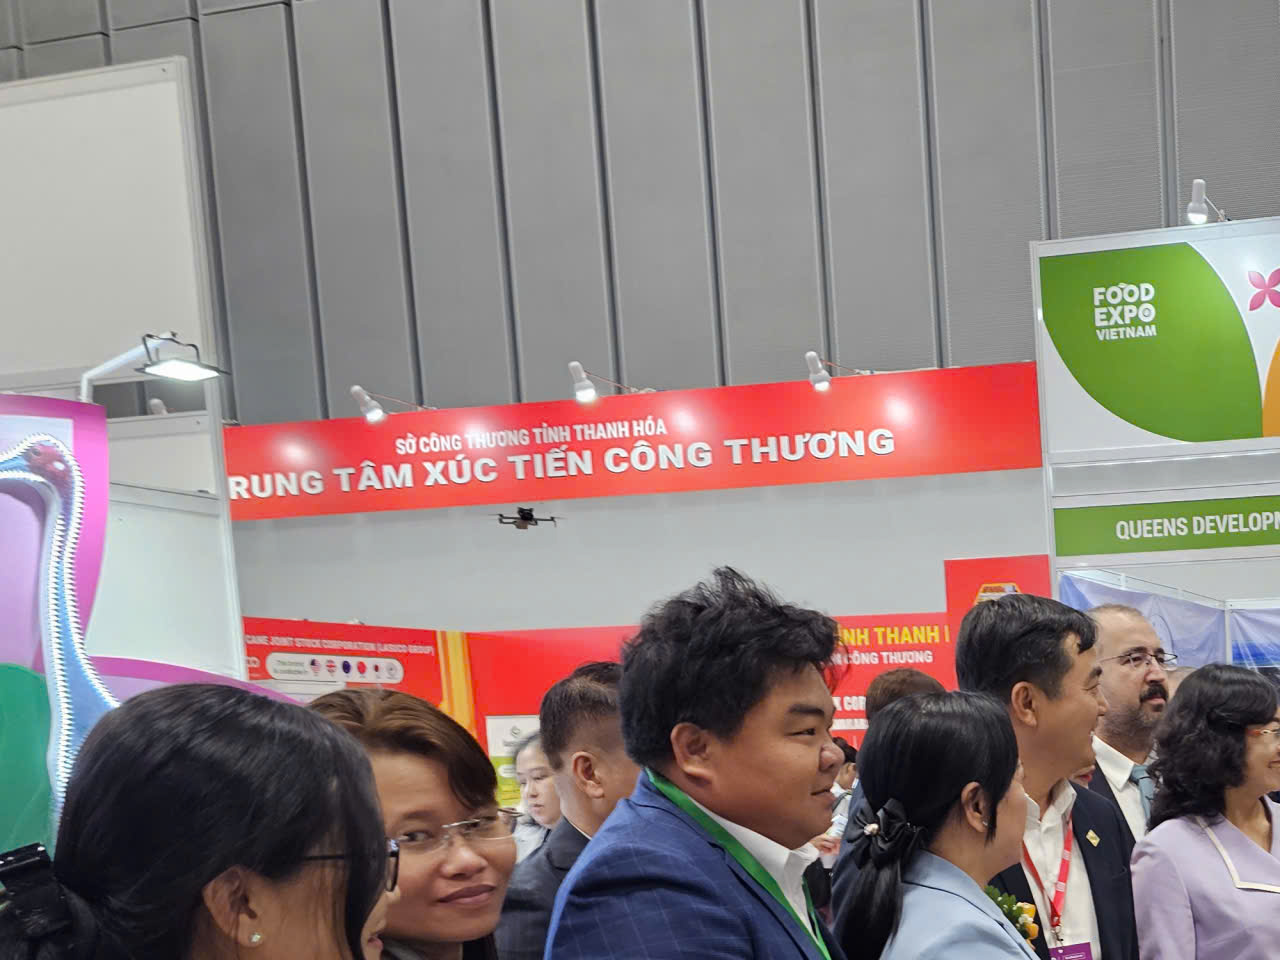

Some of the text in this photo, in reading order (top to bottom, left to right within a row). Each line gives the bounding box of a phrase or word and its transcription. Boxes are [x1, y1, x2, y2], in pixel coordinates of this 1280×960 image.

[1093, 282, 1155, 305] FOOD
[1094, 303, 1156, 326] EXPO
[1096, 325, 1157, 341] VIETNAM
[419, 432, 462, 453] CÔNG
[573, 420, 630, 441] THANH
[633, 415, 667, 437] HÓA
[228, 428, 895, 500] RUNG TÂM XÚC TIẾN CÔNG THƯƠNG
[1116, 517, 1188, 540] QUEENS
[873, 625, 940, 645] THANH
